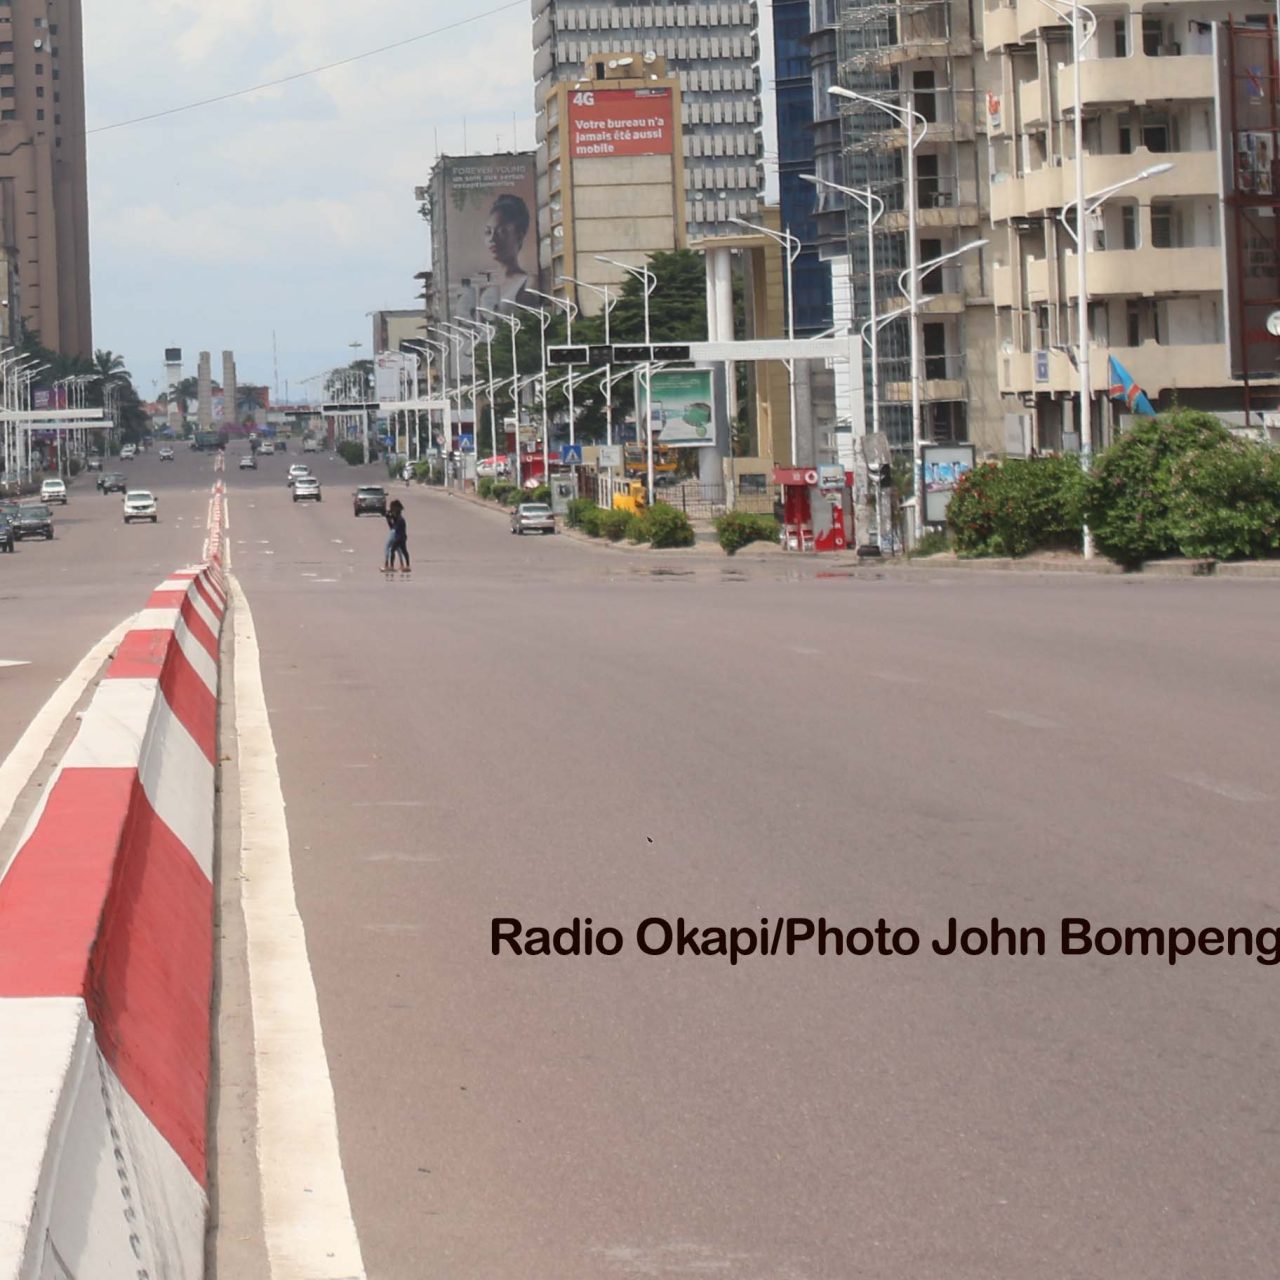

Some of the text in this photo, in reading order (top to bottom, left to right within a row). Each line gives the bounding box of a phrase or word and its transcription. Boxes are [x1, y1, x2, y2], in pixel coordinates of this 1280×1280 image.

[573, 92, 594, 105] 4G
[575, 117, 664, 129] Votre bureau n'a
[575, 128, 662, 143] jamais été aussi
[576, 143, 614, 154] mobile
[452, 167, 494, 175] FOREVER
